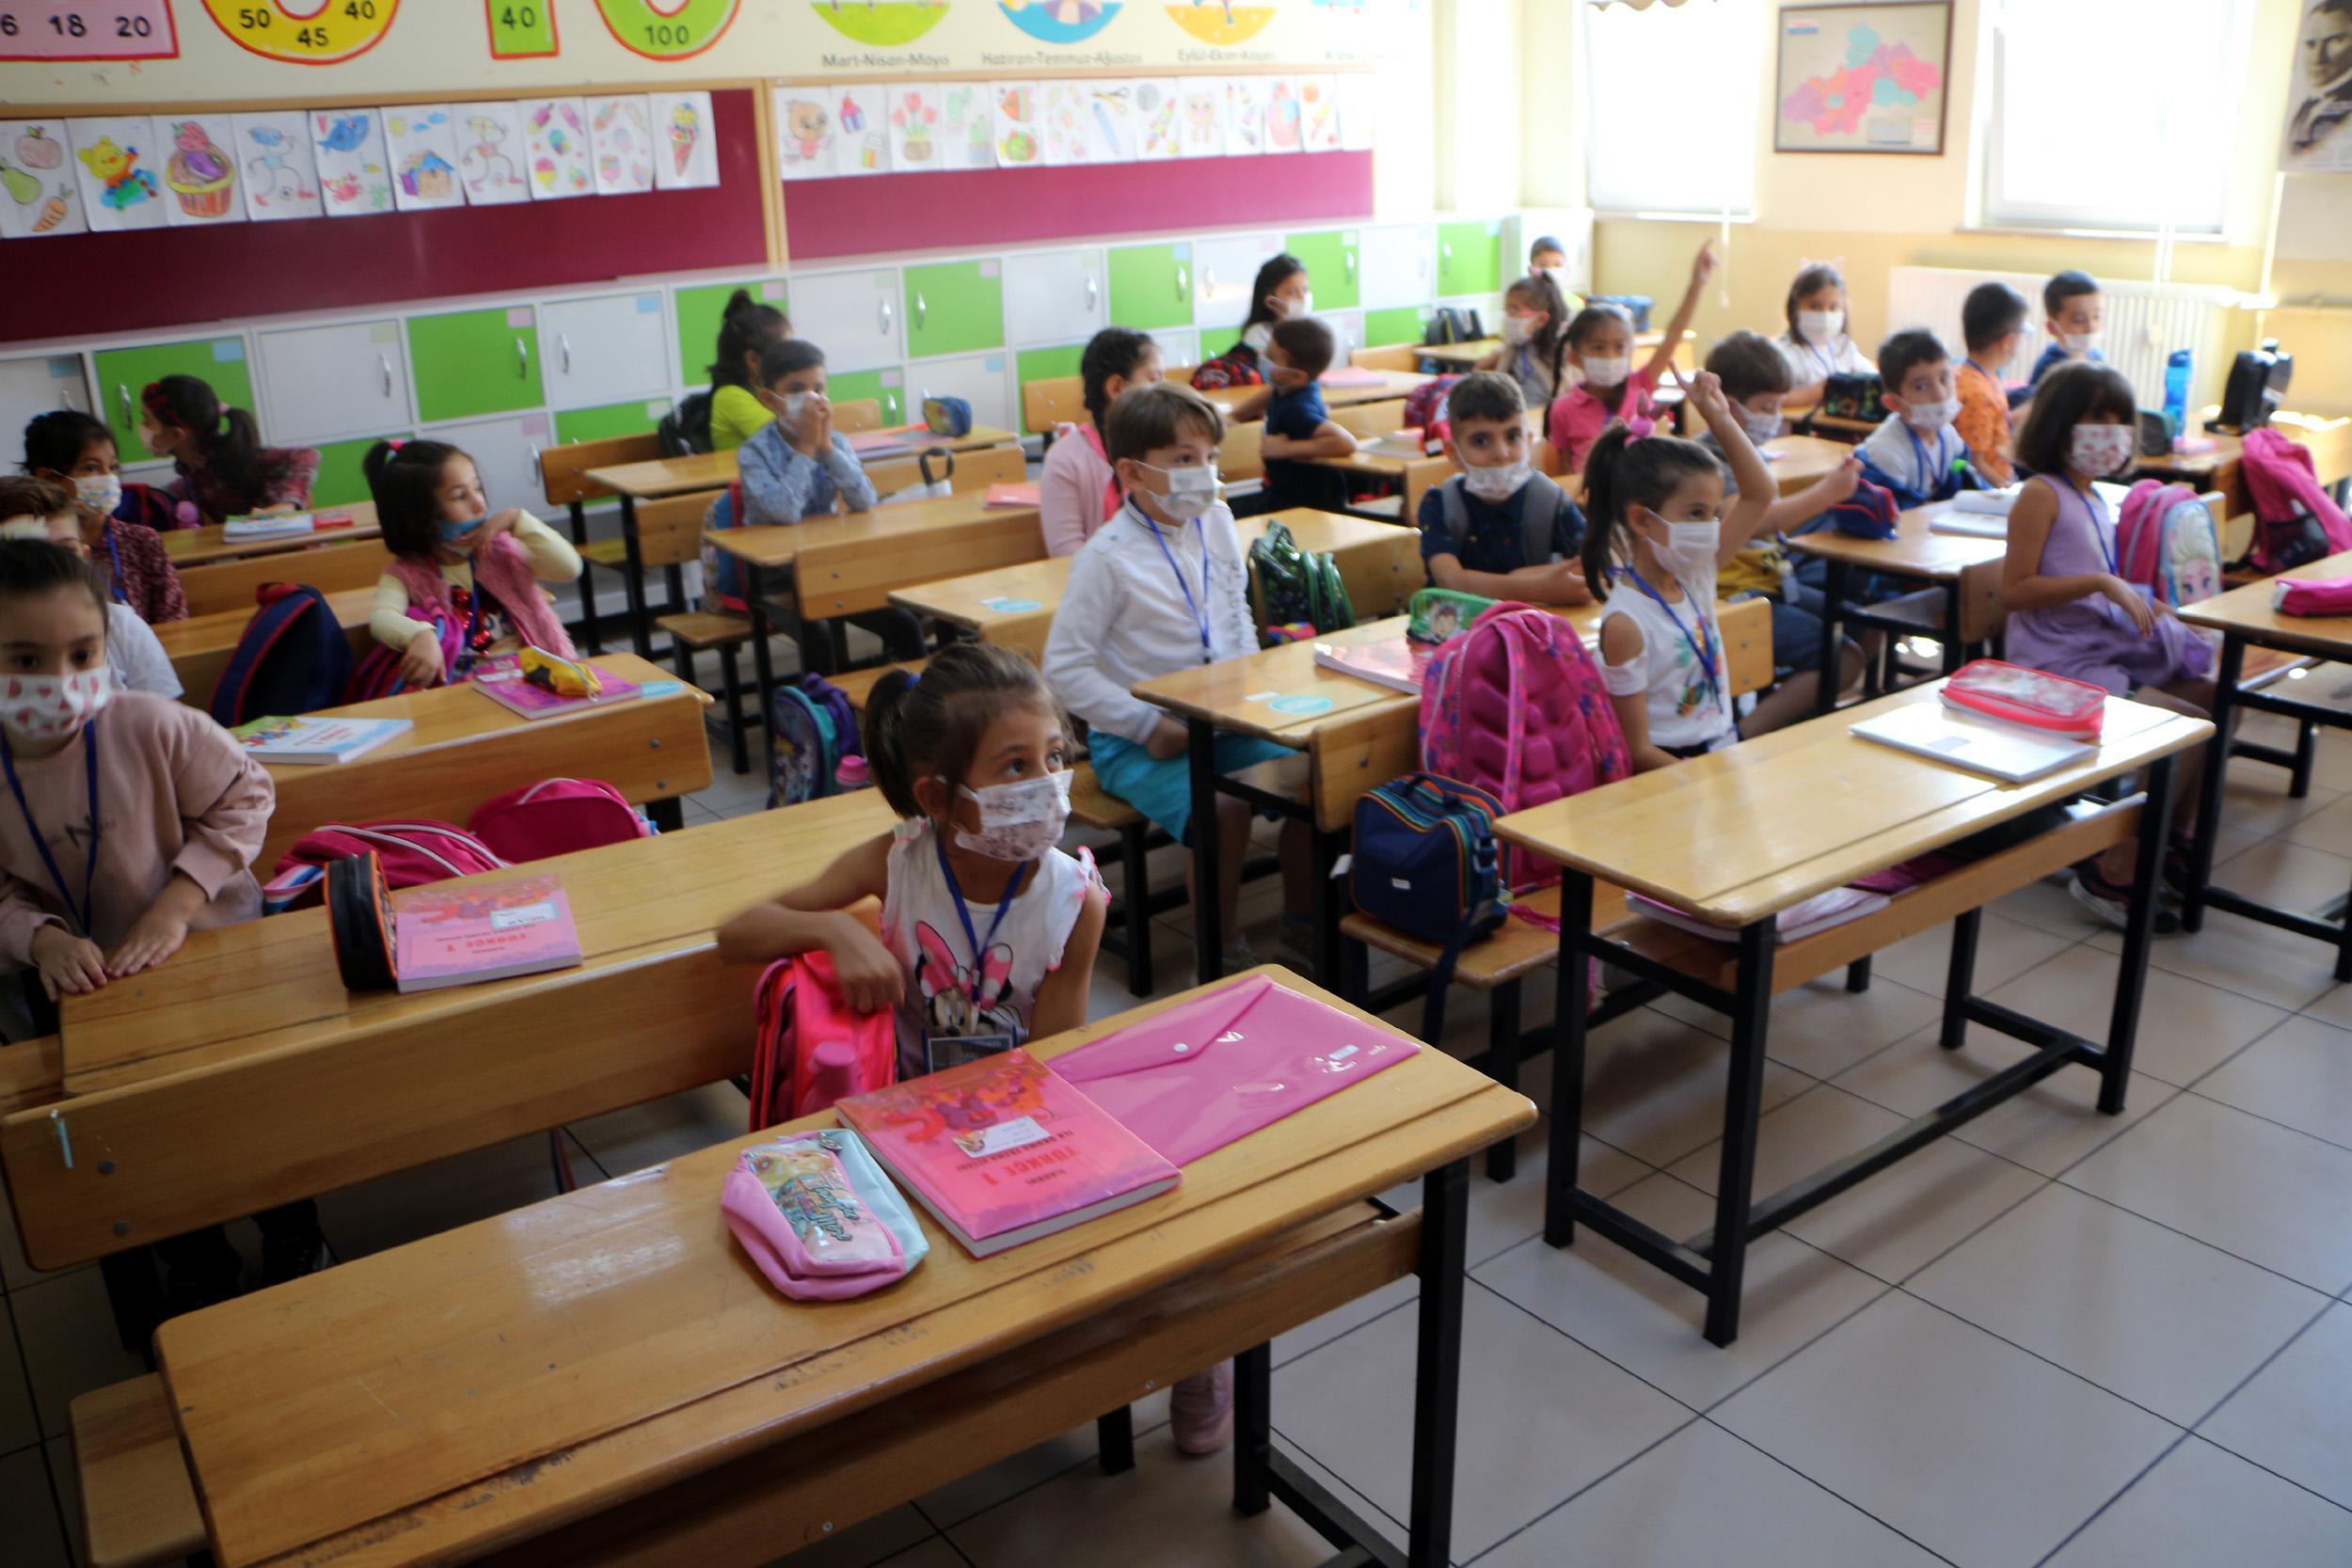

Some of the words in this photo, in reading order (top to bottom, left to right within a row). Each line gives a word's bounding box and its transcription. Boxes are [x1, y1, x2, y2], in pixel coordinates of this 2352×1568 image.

[240, 8, 270, 28] 50
[344, 1, 375, 20] 40
[501, 7, 535, 29] 40
[48, 14, 87, 37] 18
[115, 16, 151, 37] 20
[644, 25, 690, 45] 100
[297, 27, 328, 47] 45
